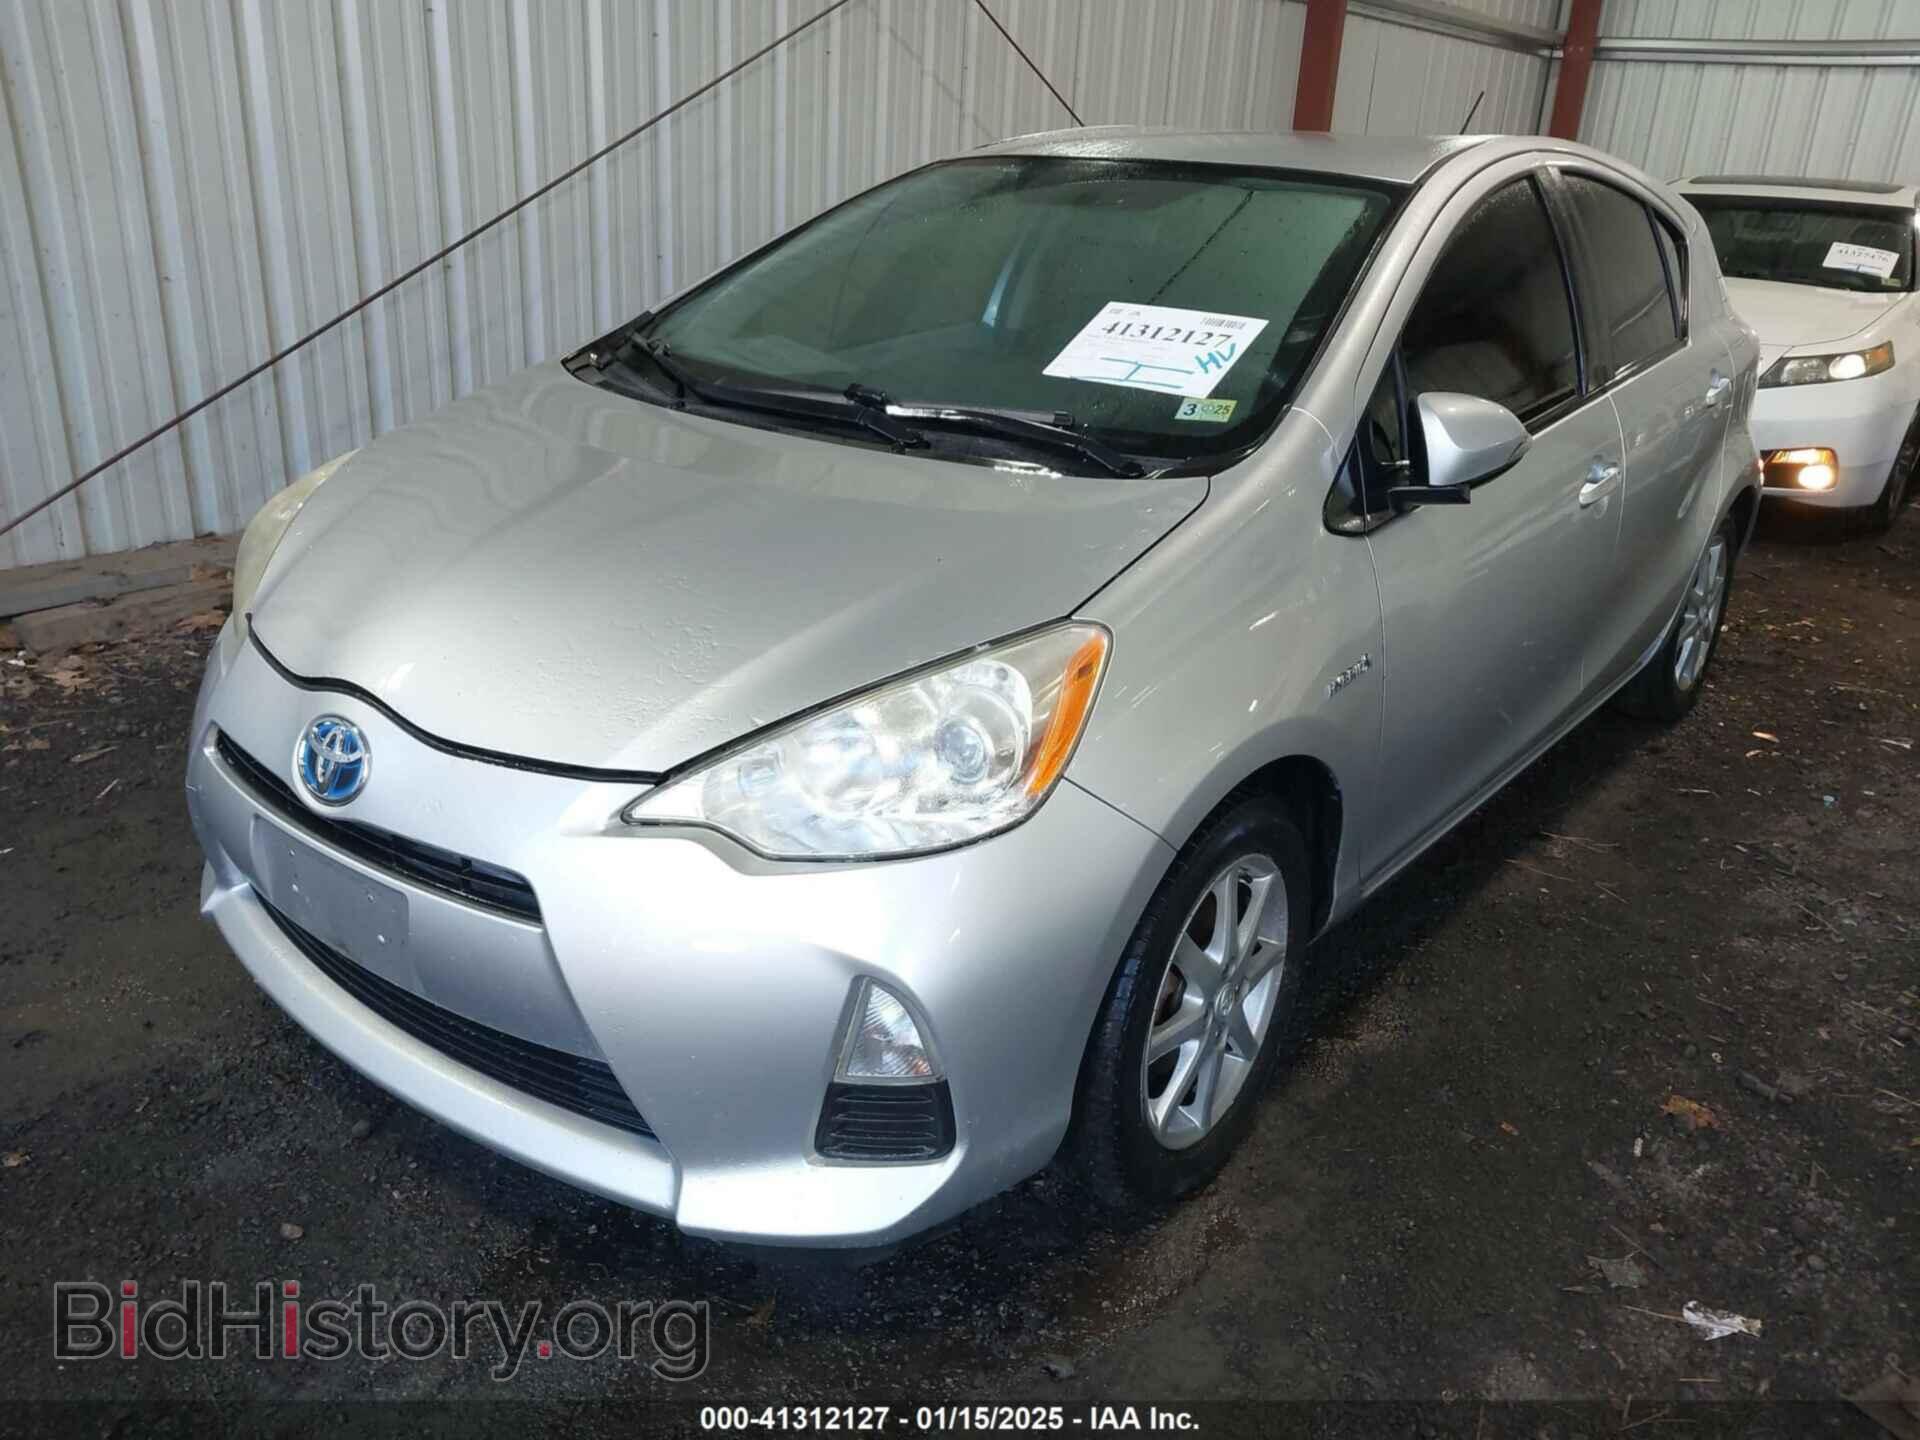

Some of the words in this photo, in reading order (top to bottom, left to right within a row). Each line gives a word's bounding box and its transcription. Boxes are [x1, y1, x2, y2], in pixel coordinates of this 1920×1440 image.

[1102, 321, 1233, 348] 41312127
[1183, 402, 1197, 417] 3
[1215, 404, 1232, 416] 25
